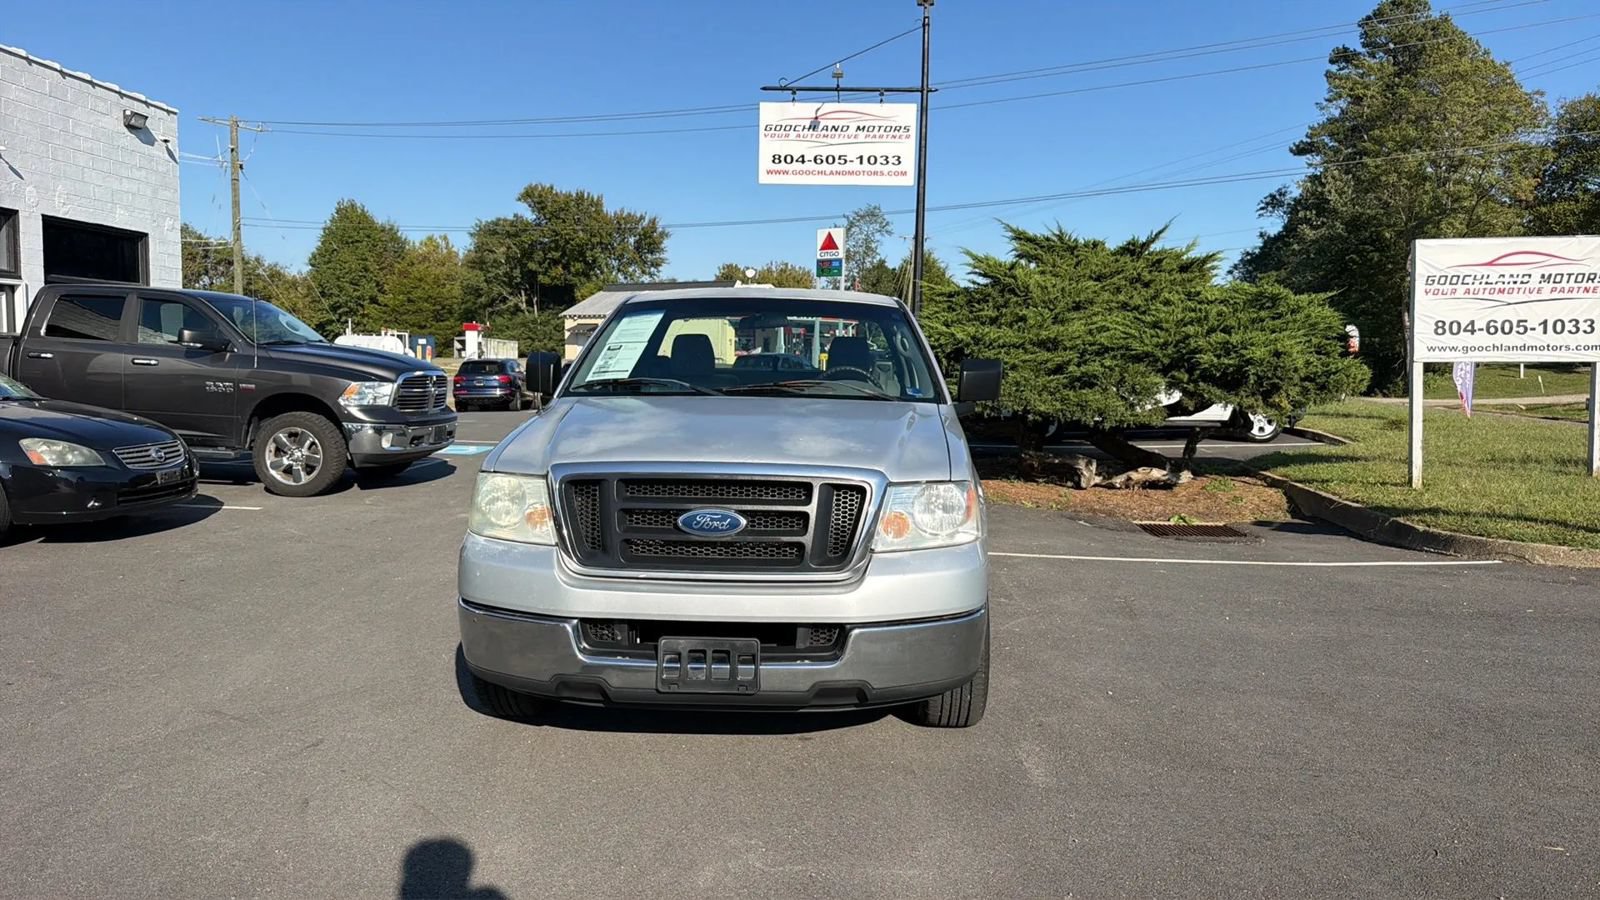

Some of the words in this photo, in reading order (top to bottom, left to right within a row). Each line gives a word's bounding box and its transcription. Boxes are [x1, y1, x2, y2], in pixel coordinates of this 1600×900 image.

[763, 123, 850, 133] GOOCHLAND
[855, 124, 912, 133] MOTORS
[771, 153, 902, 166] 804-605-1033
[766, 168, 908, 177] WWW.GOOCHLANDMOTORS.COM
[1425, 273, 1532, 286] GOOCHLAND
[1424, 288, 1458, 297] YOUR
[1463, 286, 1544, 296] AUTOMOTIVE
[1550, 286, 1600, 295] PARTNE
[1433, 318, 1596, 336] 804-605-1033
[1427, 343, 1600, 355] www.goochlandmotors.com
[692, 513, 731, 530] Ford
